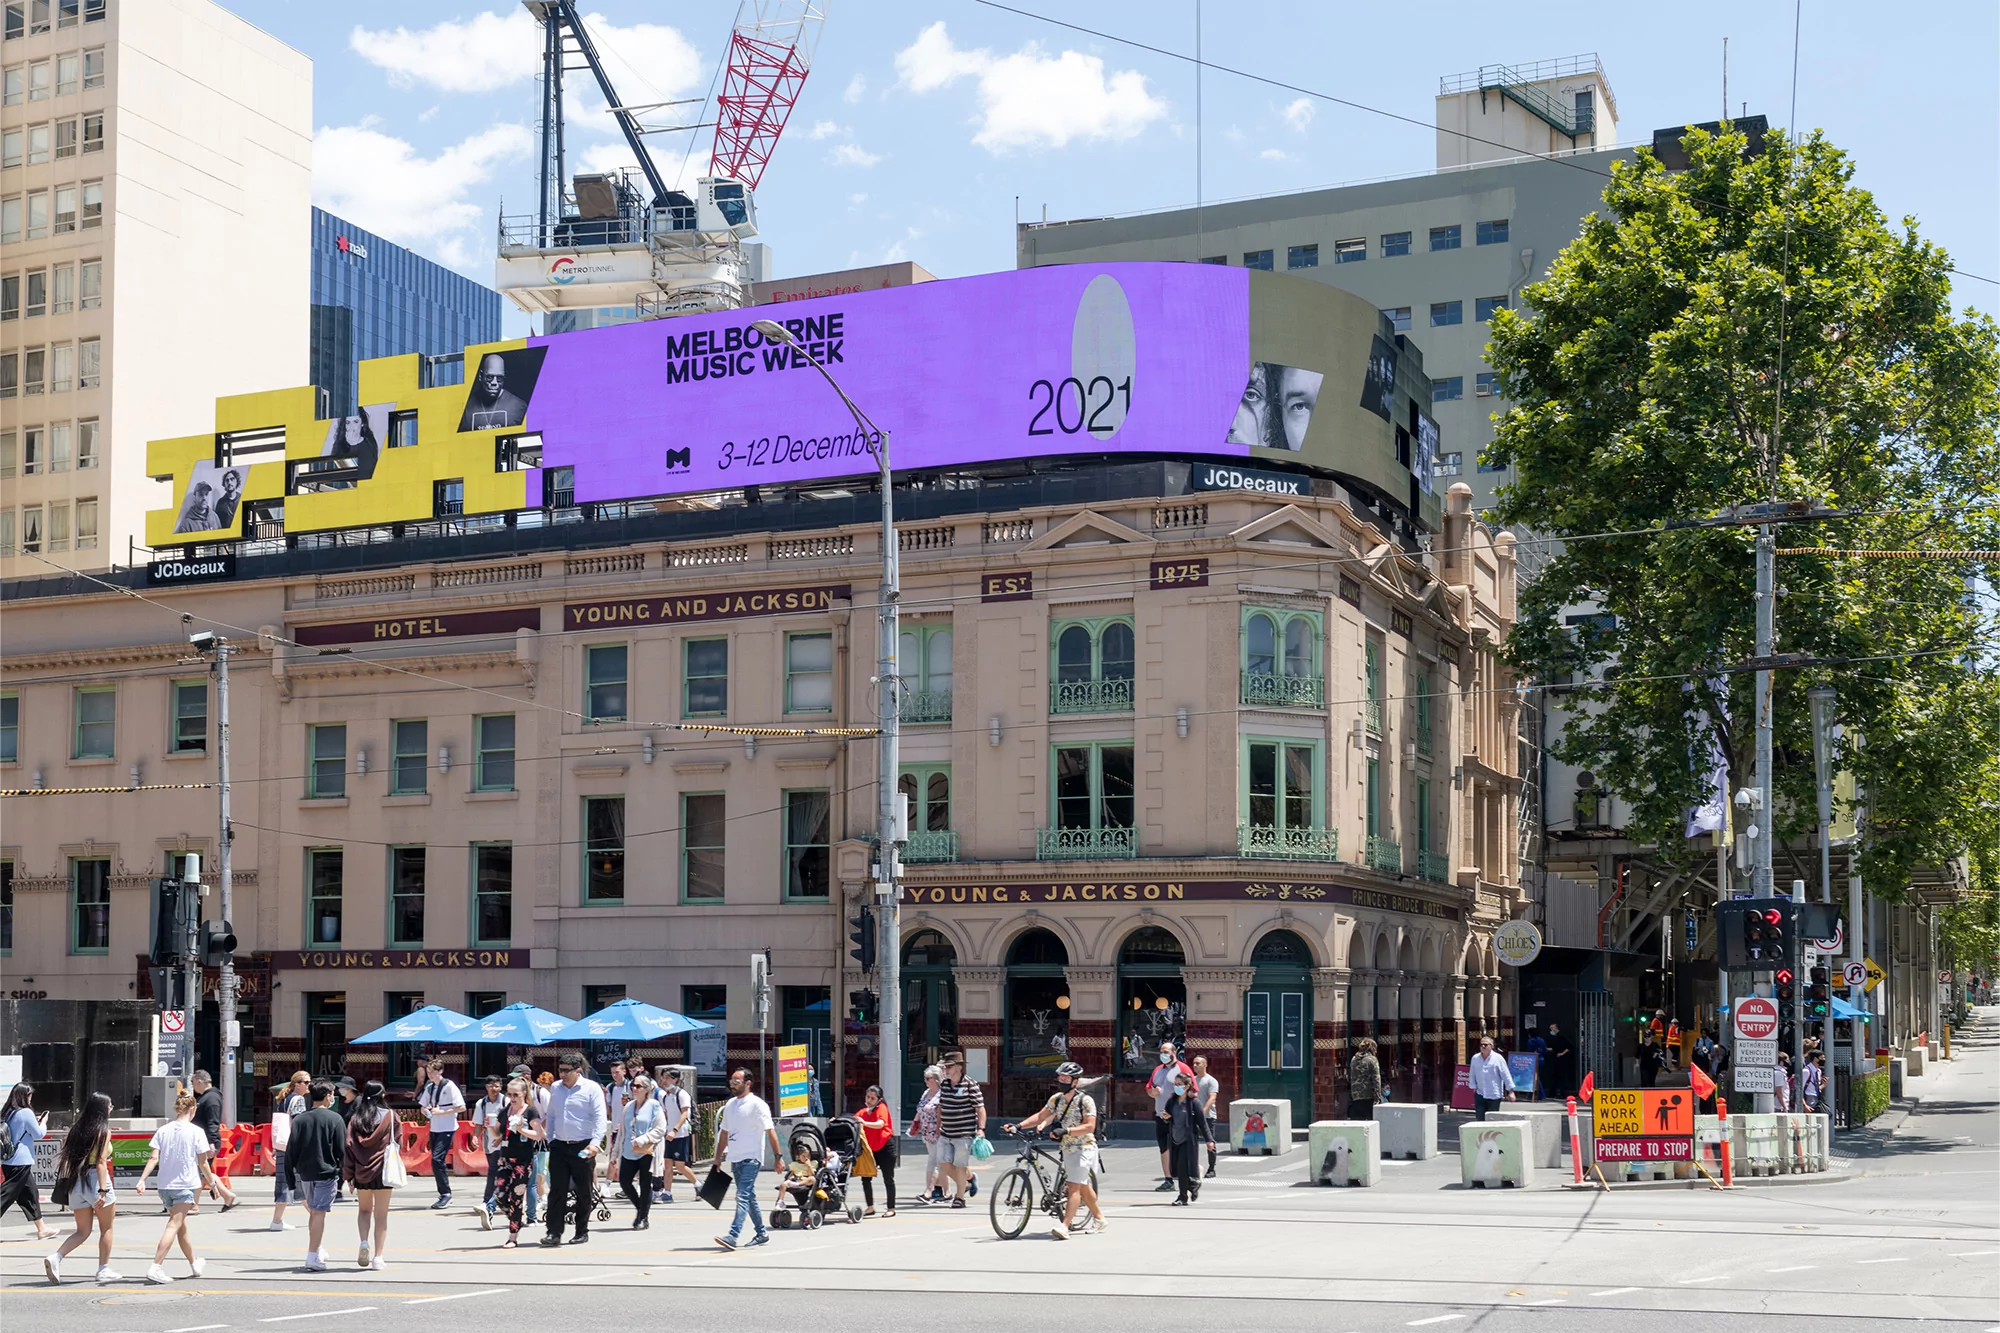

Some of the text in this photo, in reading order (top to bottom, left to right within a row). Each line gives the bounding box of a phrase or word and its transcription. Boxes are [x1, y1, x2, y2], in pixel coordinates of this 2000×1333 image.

[349, 243, 368, 258] nab
[563, 266, 615, 274] METROTUNNEL
[667, 340, 843, 384] MUSIC WEEK
[1028, 375, 1131, 436] 2021
[1204, 469, 1298, 495] JCDecaux
[154, 562, 225, 579] JCDecaux
[1158, 564, 1201, 583] 1875
[573, 591, 834, 624] YOUNG AND JACKSON
[374, 618, 447, 638] HOTEL
[1394, 611, 1410, 635] AND
[909, 884, 1184, 903] YOUNG & JACKSON
[1352, 889, 1387, 909] PRINCE'S
[1392, 894, 1420, 913] BRIDGE
[299, 952, 510, 967] YOUNG & JACKSON
[202, 977, 258, 995] JACON
[11, 990, 47, 1000] SHOP
[1750, 1005, 1763, 1013] NO
[1741, 1023, 1772, 1032] ENTRY
[604, 1044, 620, 1052] UFC
[1737, 1070, 1772, 1078] BICYCLES
[1736, 1081, 1773, 1089] EXCEPTED
[1601, 1094, 1636, 1104] ROAD
[1600, 1108, 1637, 1119] WORK
[1599, 1122, 1639, 1133] AHEAD
[1599, 1142, 1688, 1157] PREPARE TO STOP
[37, 1158, 52, 1168] FOR
